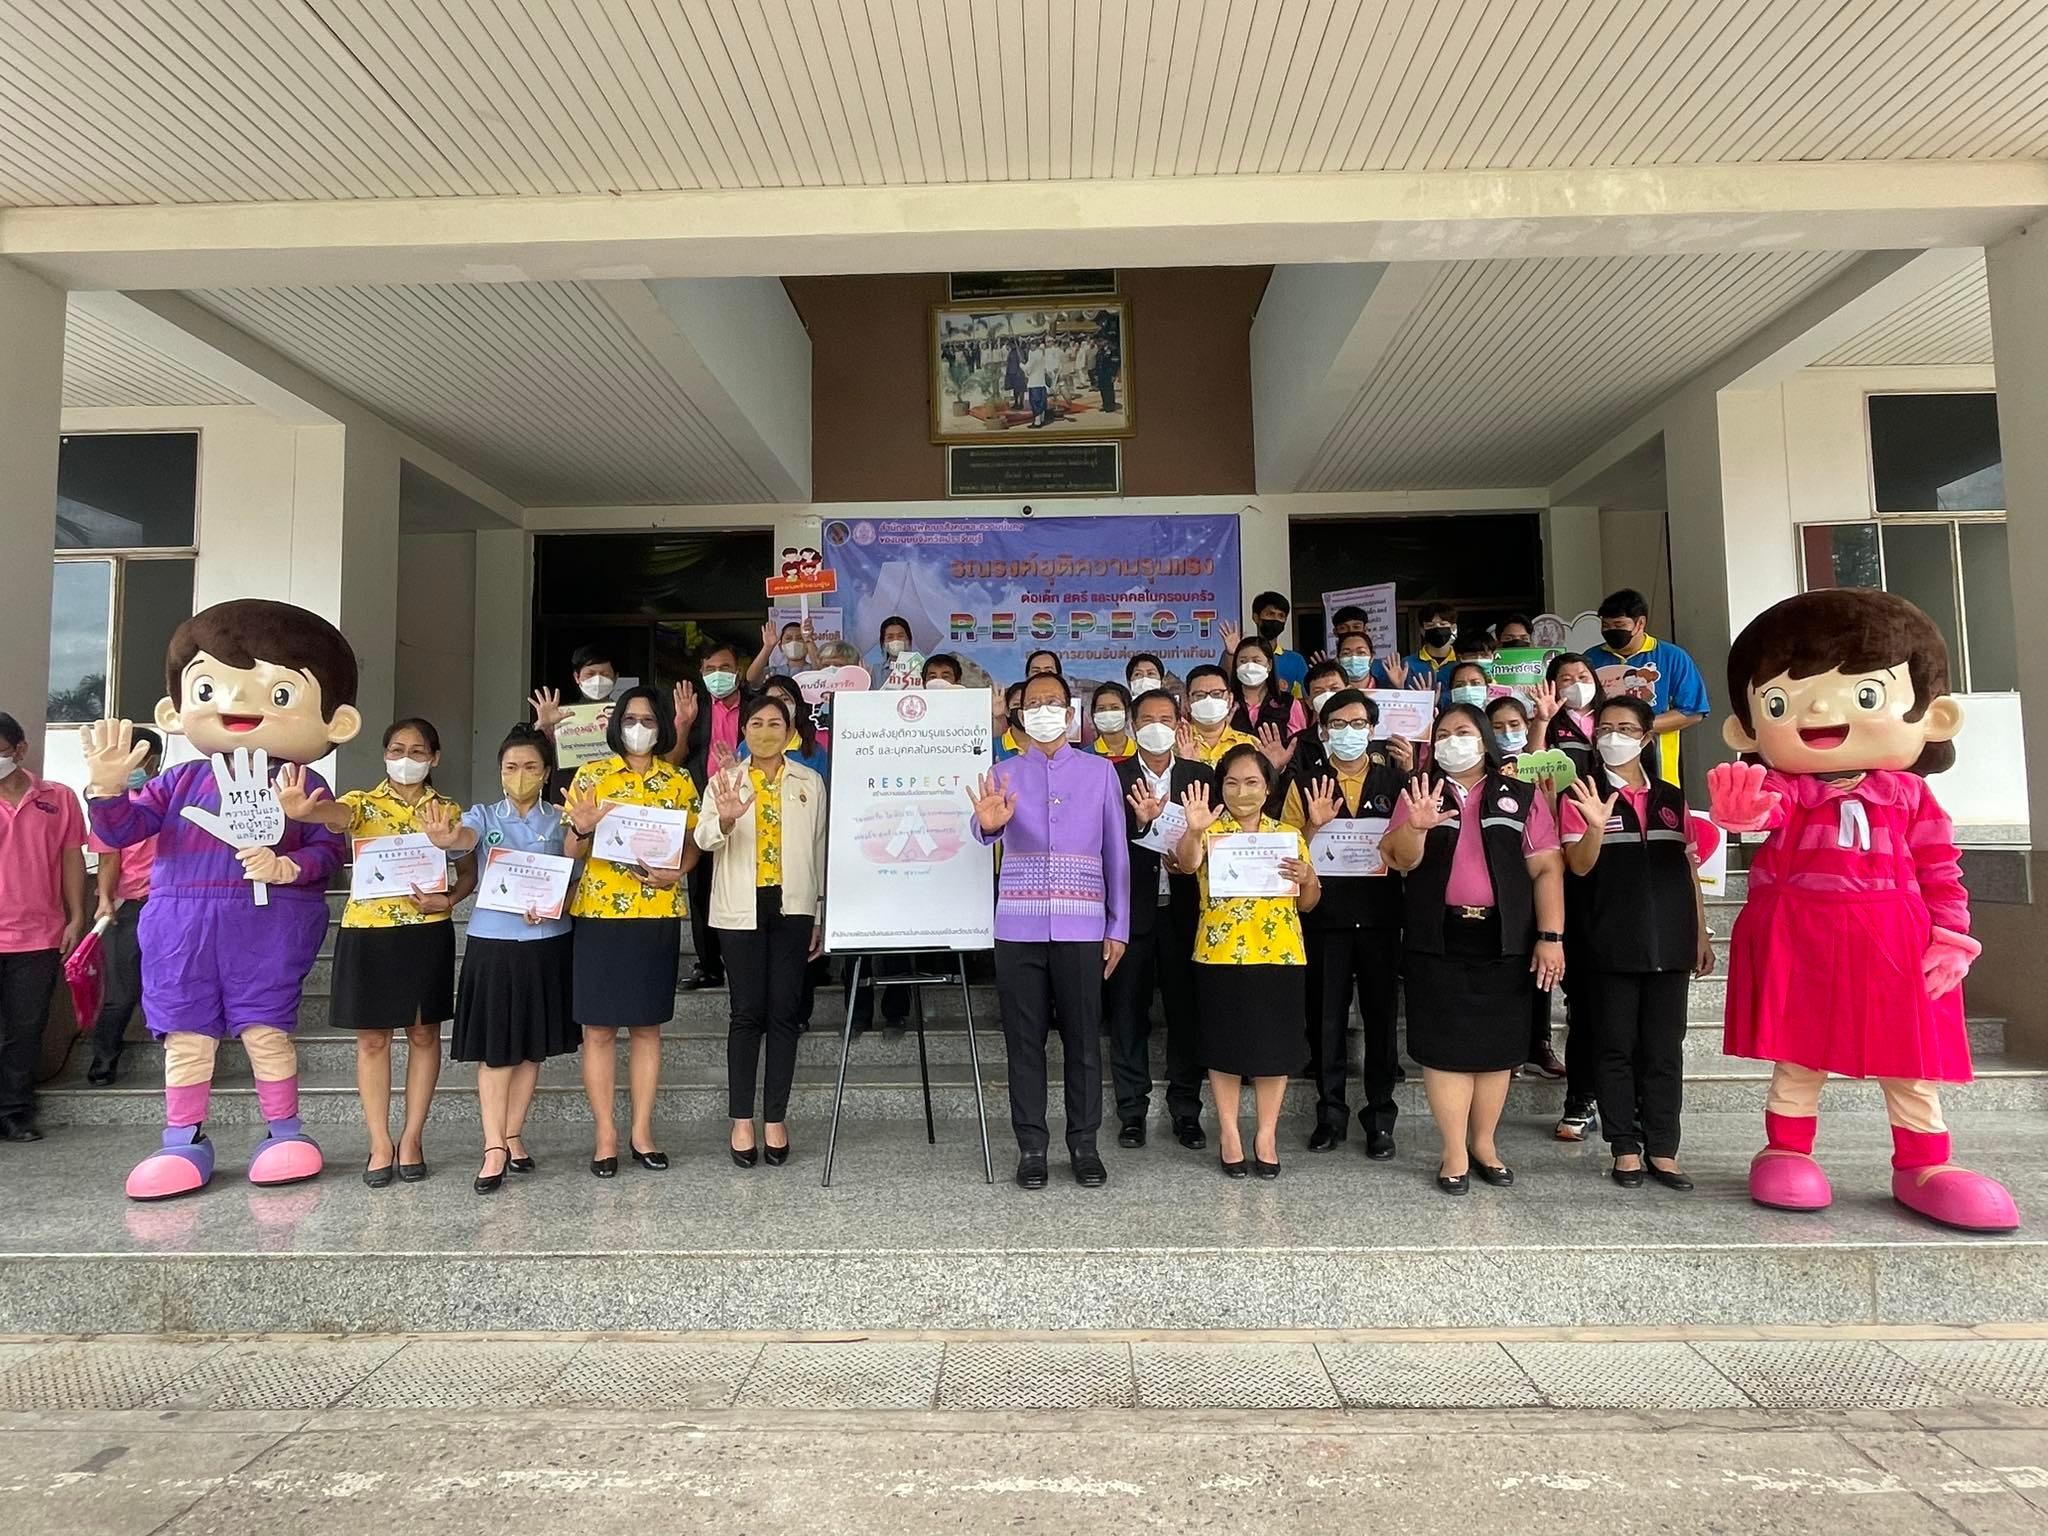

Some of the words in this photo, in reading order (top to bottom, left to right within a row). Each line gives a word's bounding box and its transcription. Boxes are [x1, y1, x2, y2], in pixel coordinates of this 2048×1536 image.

[950, 552, 1215, 586] รณรงค์ยุติความรุนแรง
[1021, 589, 1060, 604] ต่อเด็ก
[1063, 589, 1088, 604] สตรี
[841, 725, 988, 740] ร่วมส่งพลังยุติความรุนแรงต่อเด็ก
[855, 744, 875, 756] สตรี
[878, 743, 972, 757] และบุคคลในครอบครัว
[225, 806, 280, 820] ความรุนแรง
